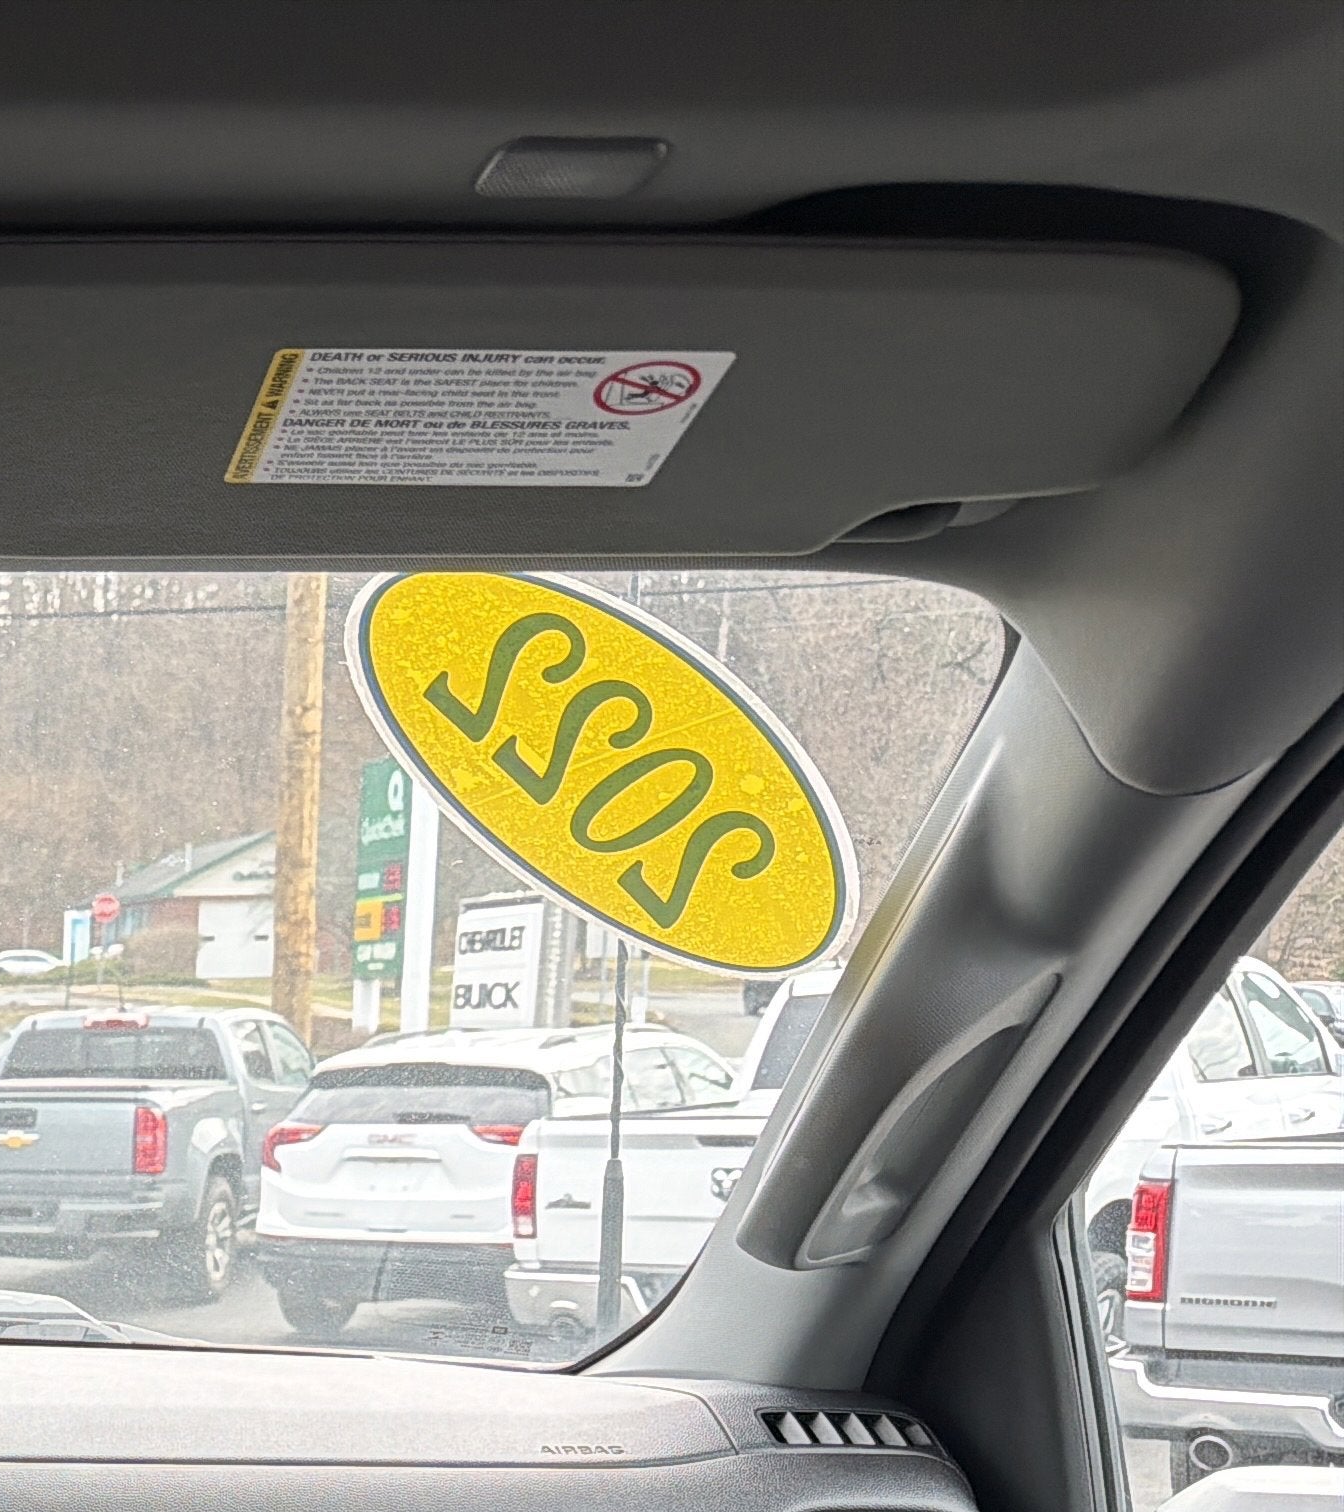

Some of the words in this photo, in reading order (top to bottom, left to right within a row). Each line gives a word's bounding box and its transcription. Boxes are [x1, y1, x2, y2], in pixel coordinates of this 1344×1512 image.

[310, 353, 363, 362] DEATH
[366, 354, 384, 362] or
[387, 353, 457, 362] SERIOUS
[461, 354, 521, 363] INJURY
[524, 356, 555, 364] can
[265, 354, 297, 397] WARNING
[282, 418, 346, 428] DANGER
[350, 419, 373, 428] DE
[375, 420, 421, 428] MORT
[423, 421, 444, 429] ou
[447, 421, 467, 429] de
[470, 421, 562, 430] BLESSURES
[453, 981, 520, 1009] BUICK
[541, 1445, 625, 1456] AIRBAG
